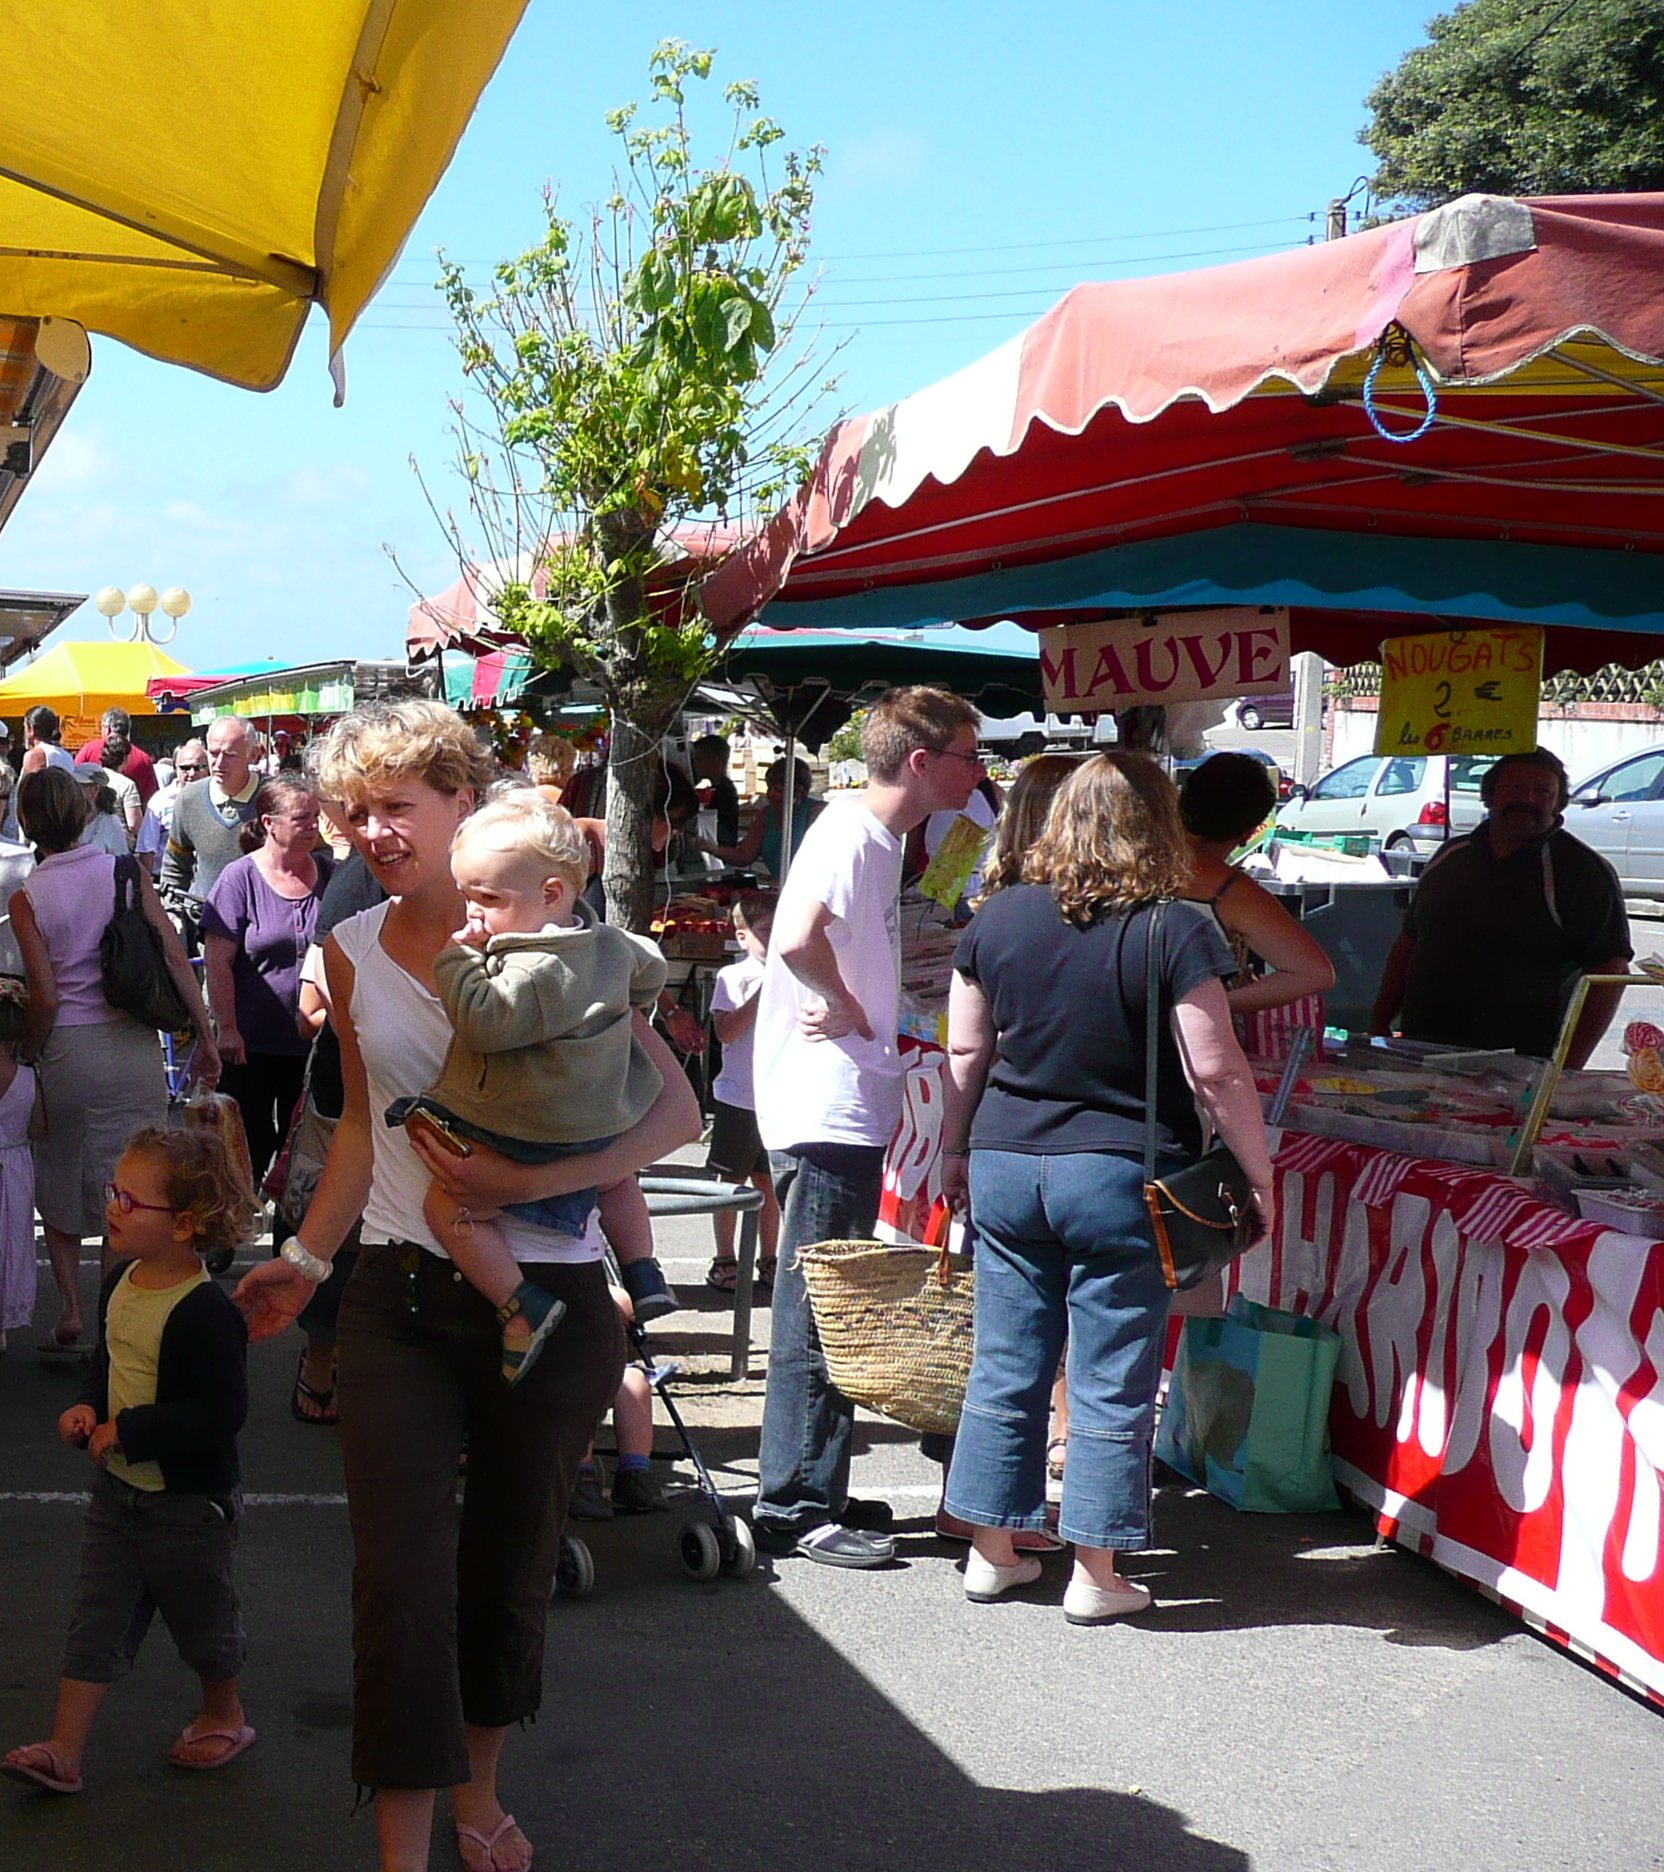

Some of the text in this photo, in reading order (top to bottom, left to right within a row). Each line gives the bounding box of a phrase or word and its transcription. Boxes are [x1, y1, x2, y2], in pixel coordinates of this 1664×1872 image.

[1039, 627, 1280, 700] MAUVE
[1384, 633, 1536, 681] NOUGATS
[1474, 680, 1503, 701] €
[1396, 721, 1513, 751] les 6 BARRES
